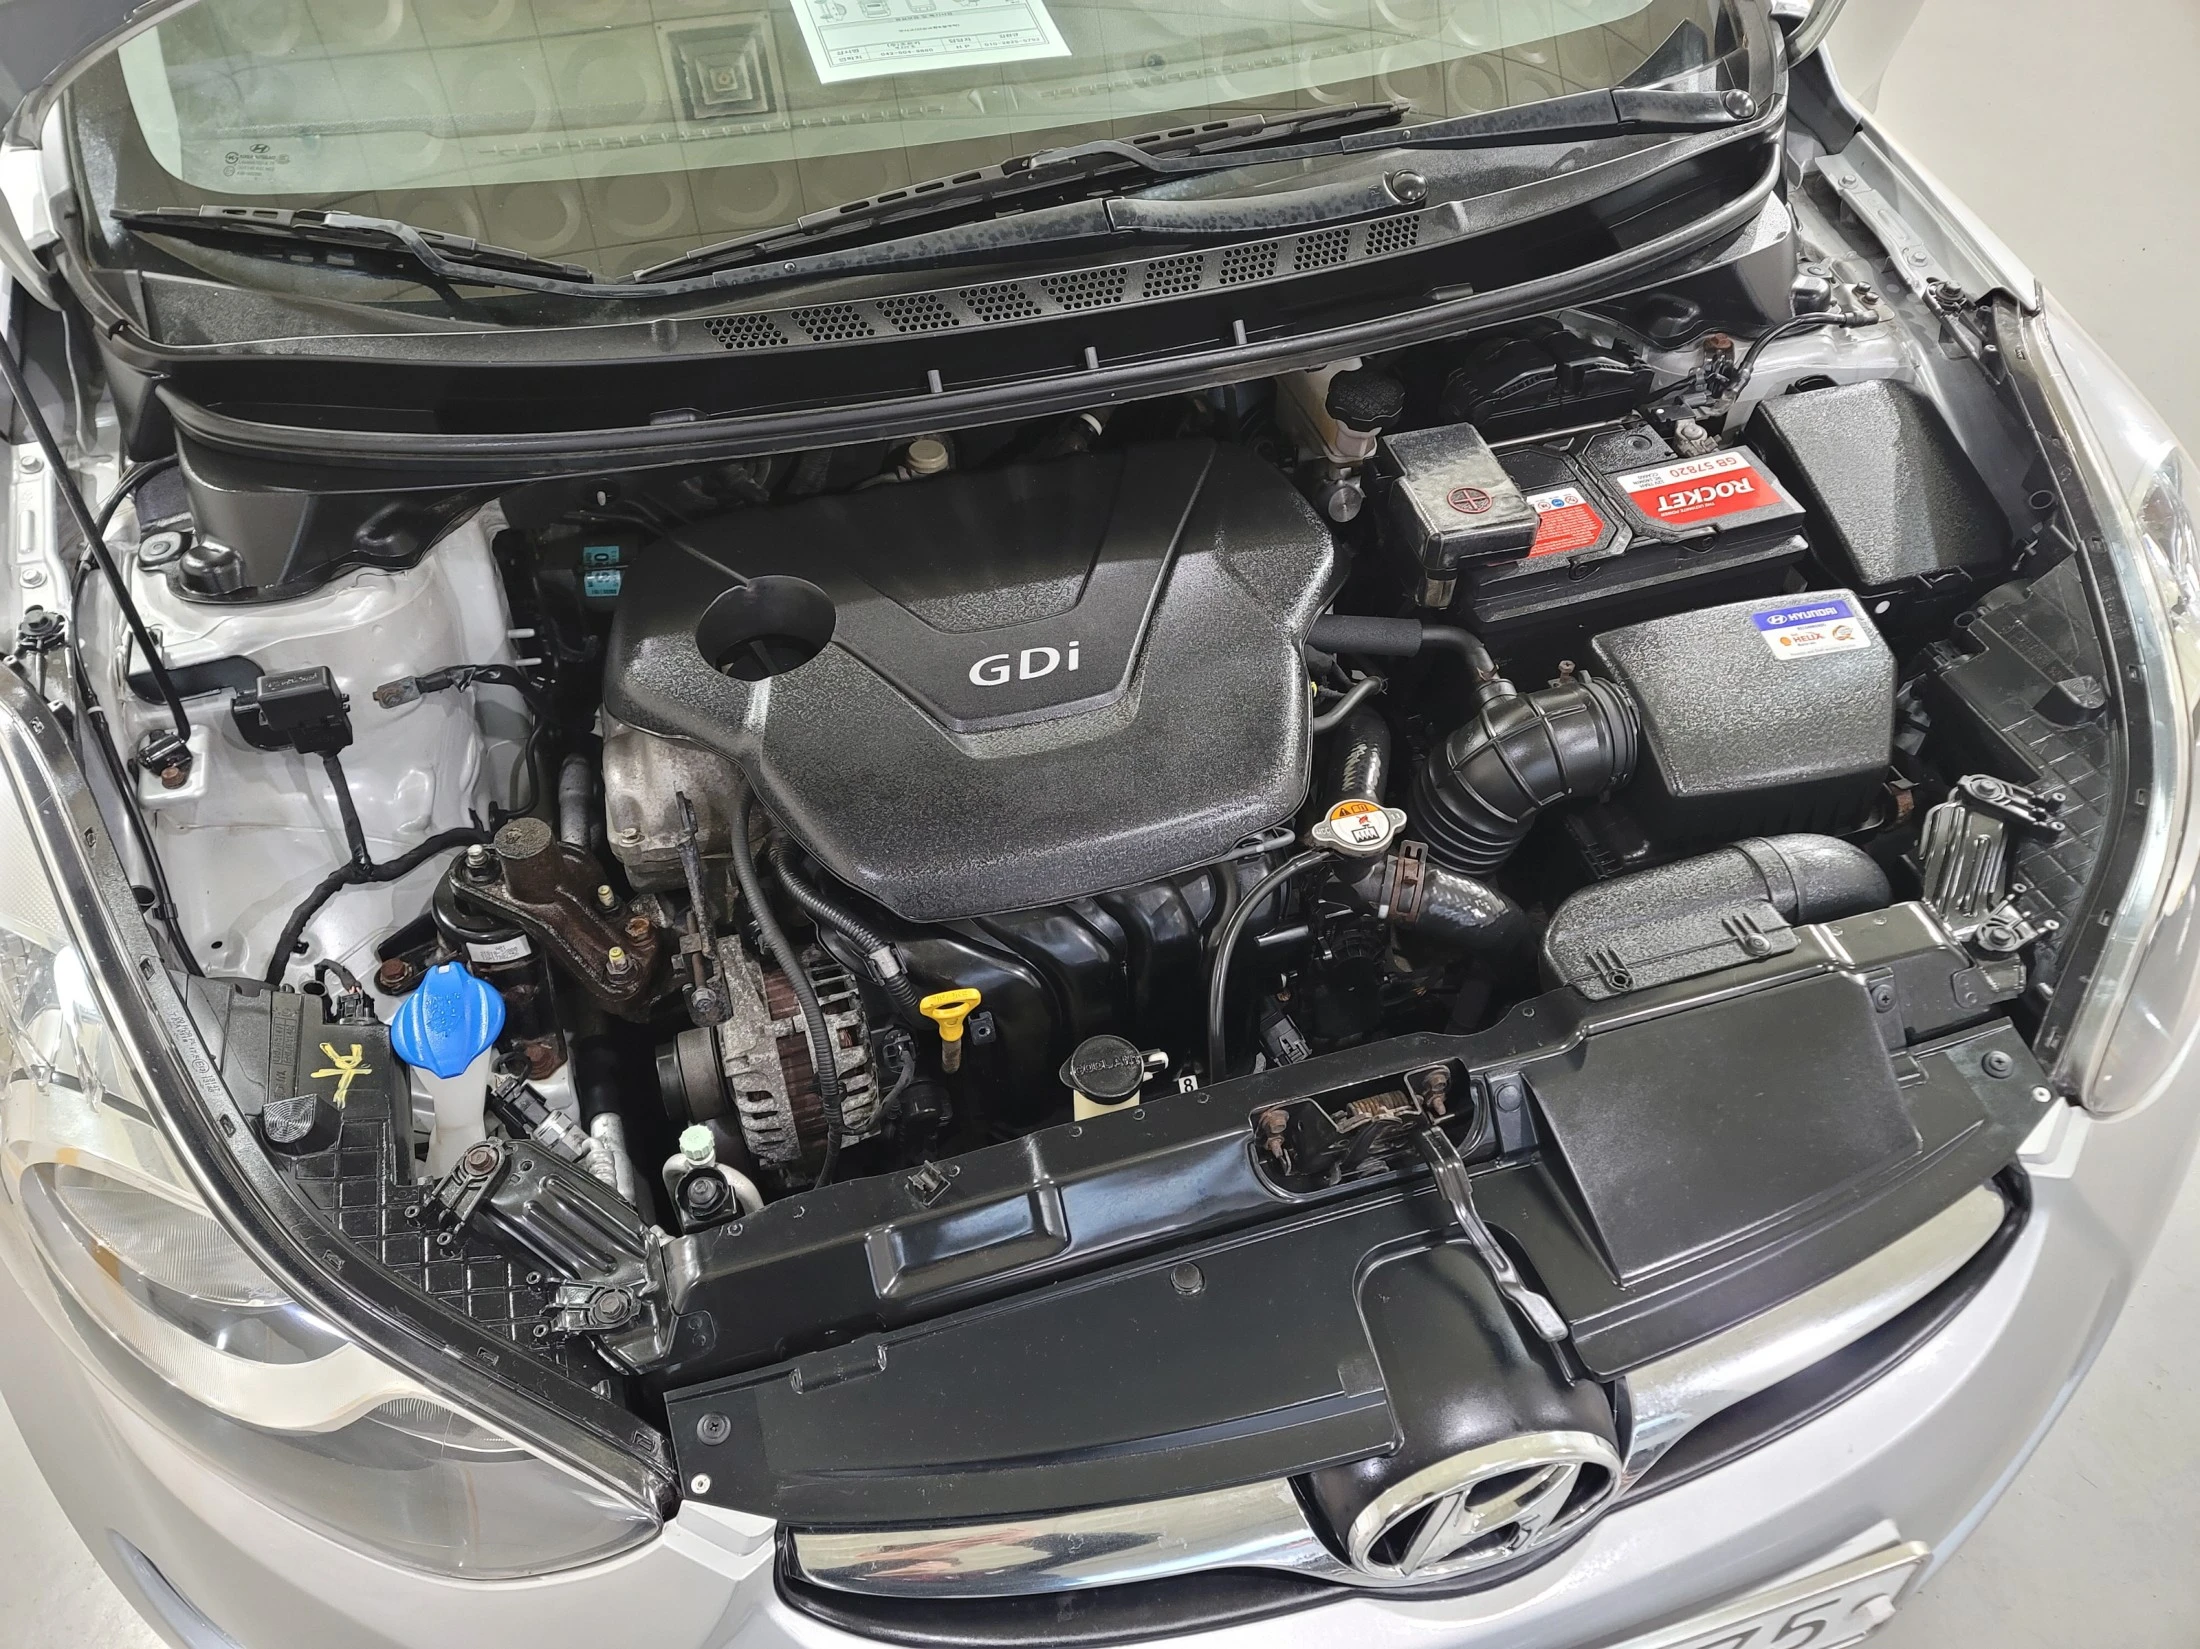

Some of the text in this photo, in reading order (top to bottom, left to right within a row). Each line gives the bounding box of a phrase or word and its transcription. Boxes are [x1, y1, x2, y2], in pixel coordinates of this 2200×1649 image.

[1669, 457, 1737, 478] GB 57820
[1657, 477, 1755, 512] ROCKET
[1788, 607, 1838, 622] HYUNDAI
[1793, 632, 1826, 643] HELIX
[967, 640, 1081, 688] GDi
[1075, 1054, 1142, 1076] COOLANT
[1183, 1078, 1194, 1093] 8
